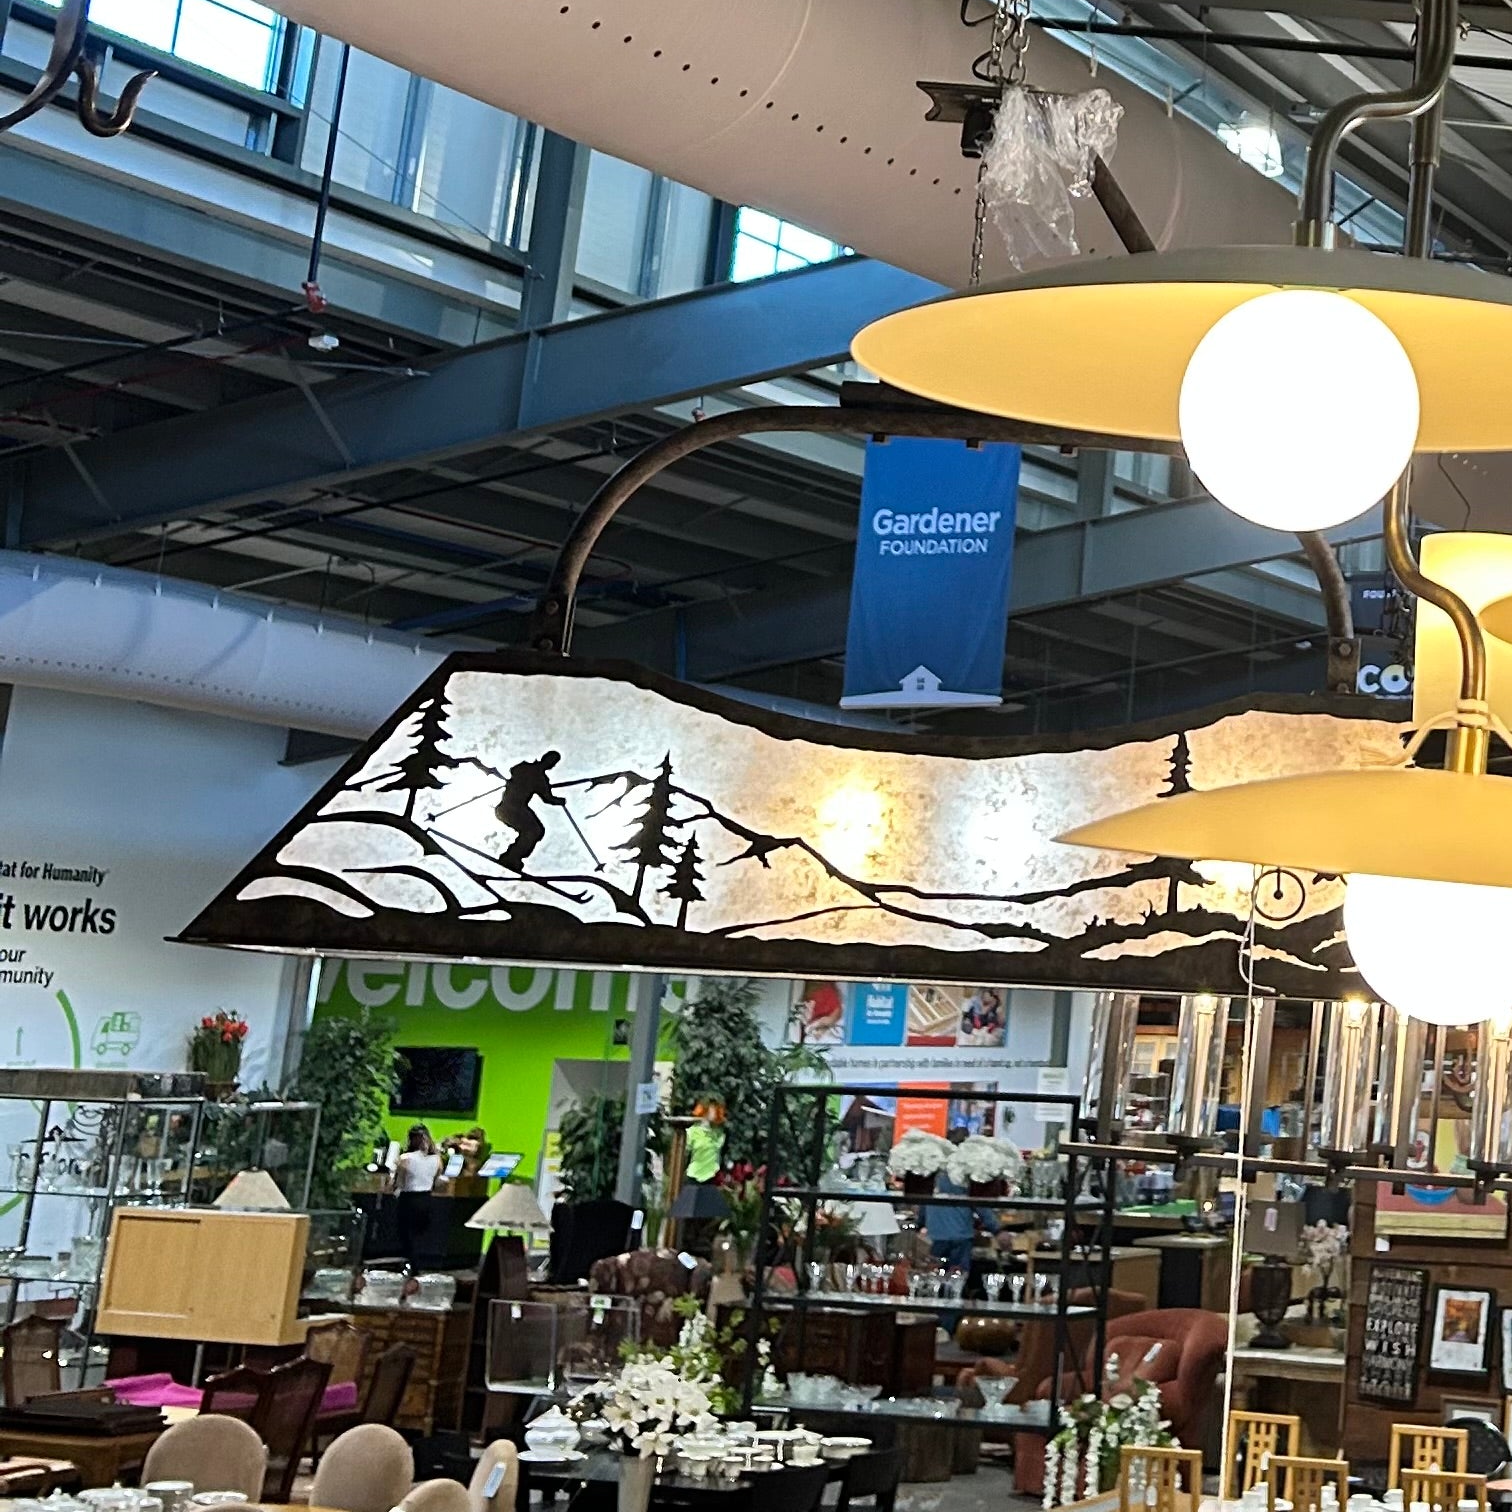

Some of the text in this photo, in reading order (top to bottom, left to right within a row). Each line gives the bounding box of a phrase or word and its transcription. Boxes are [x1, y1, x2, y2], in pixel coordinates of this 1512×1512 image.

[873, 507, 1001, 536] Gardener
[879, 538, 989, 556] FOUNDATION
[20, 861, 40, 879] for
[42, 862, 107, 887] Humanity
[24, 898, 117, 935] works
[319, 959, 692, 1014] elcom
